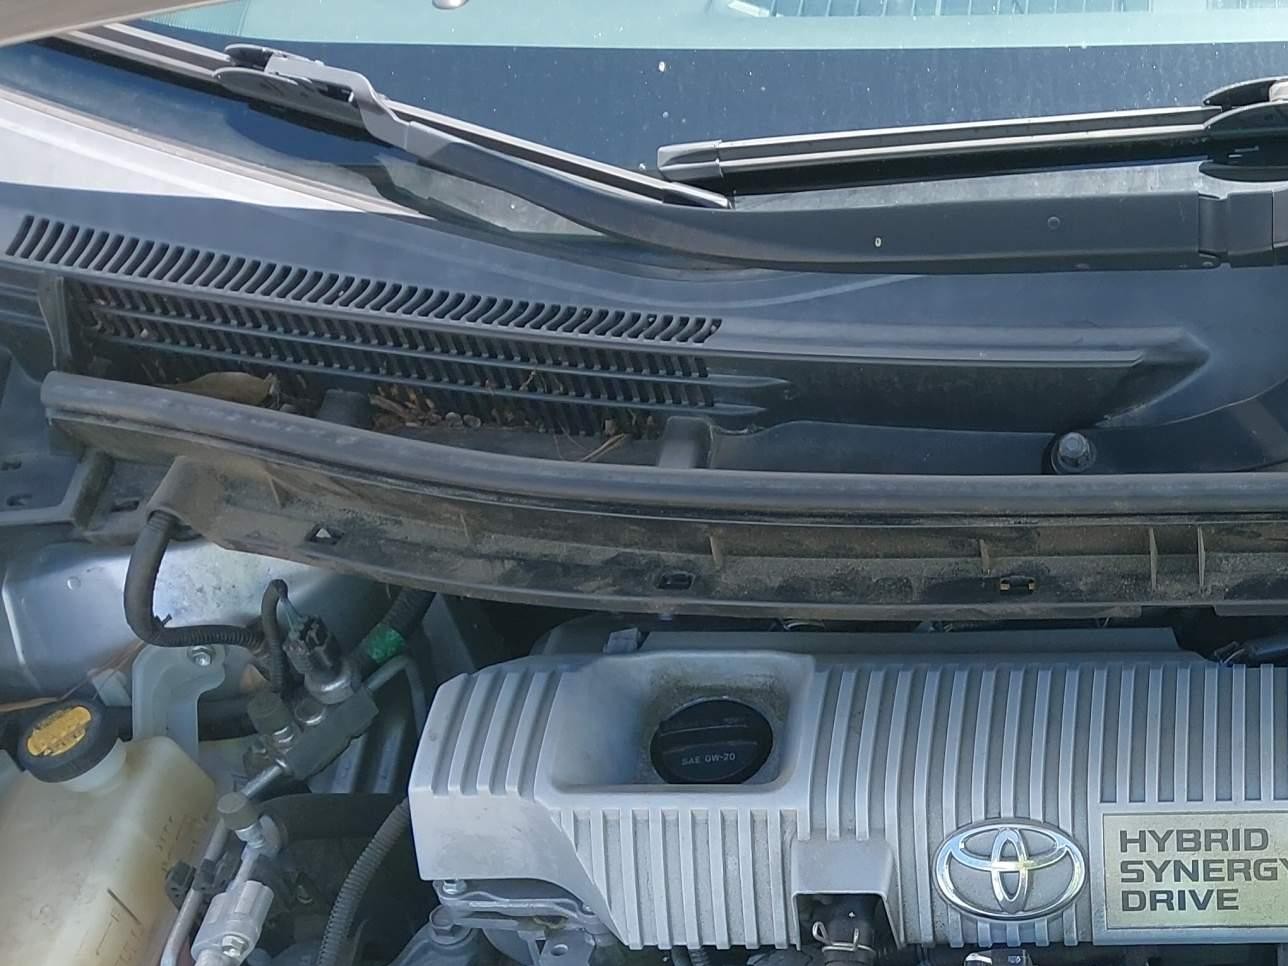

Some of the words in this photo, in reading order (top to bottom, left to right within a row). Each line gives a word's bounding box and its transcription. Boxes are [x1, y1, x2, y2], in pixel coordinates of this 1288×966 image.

[704, 752, 736, 763] 0W-20
[1119, 828, 1269, 853] HYBRID
[1121, 888, 1240, 912] DRIVE
